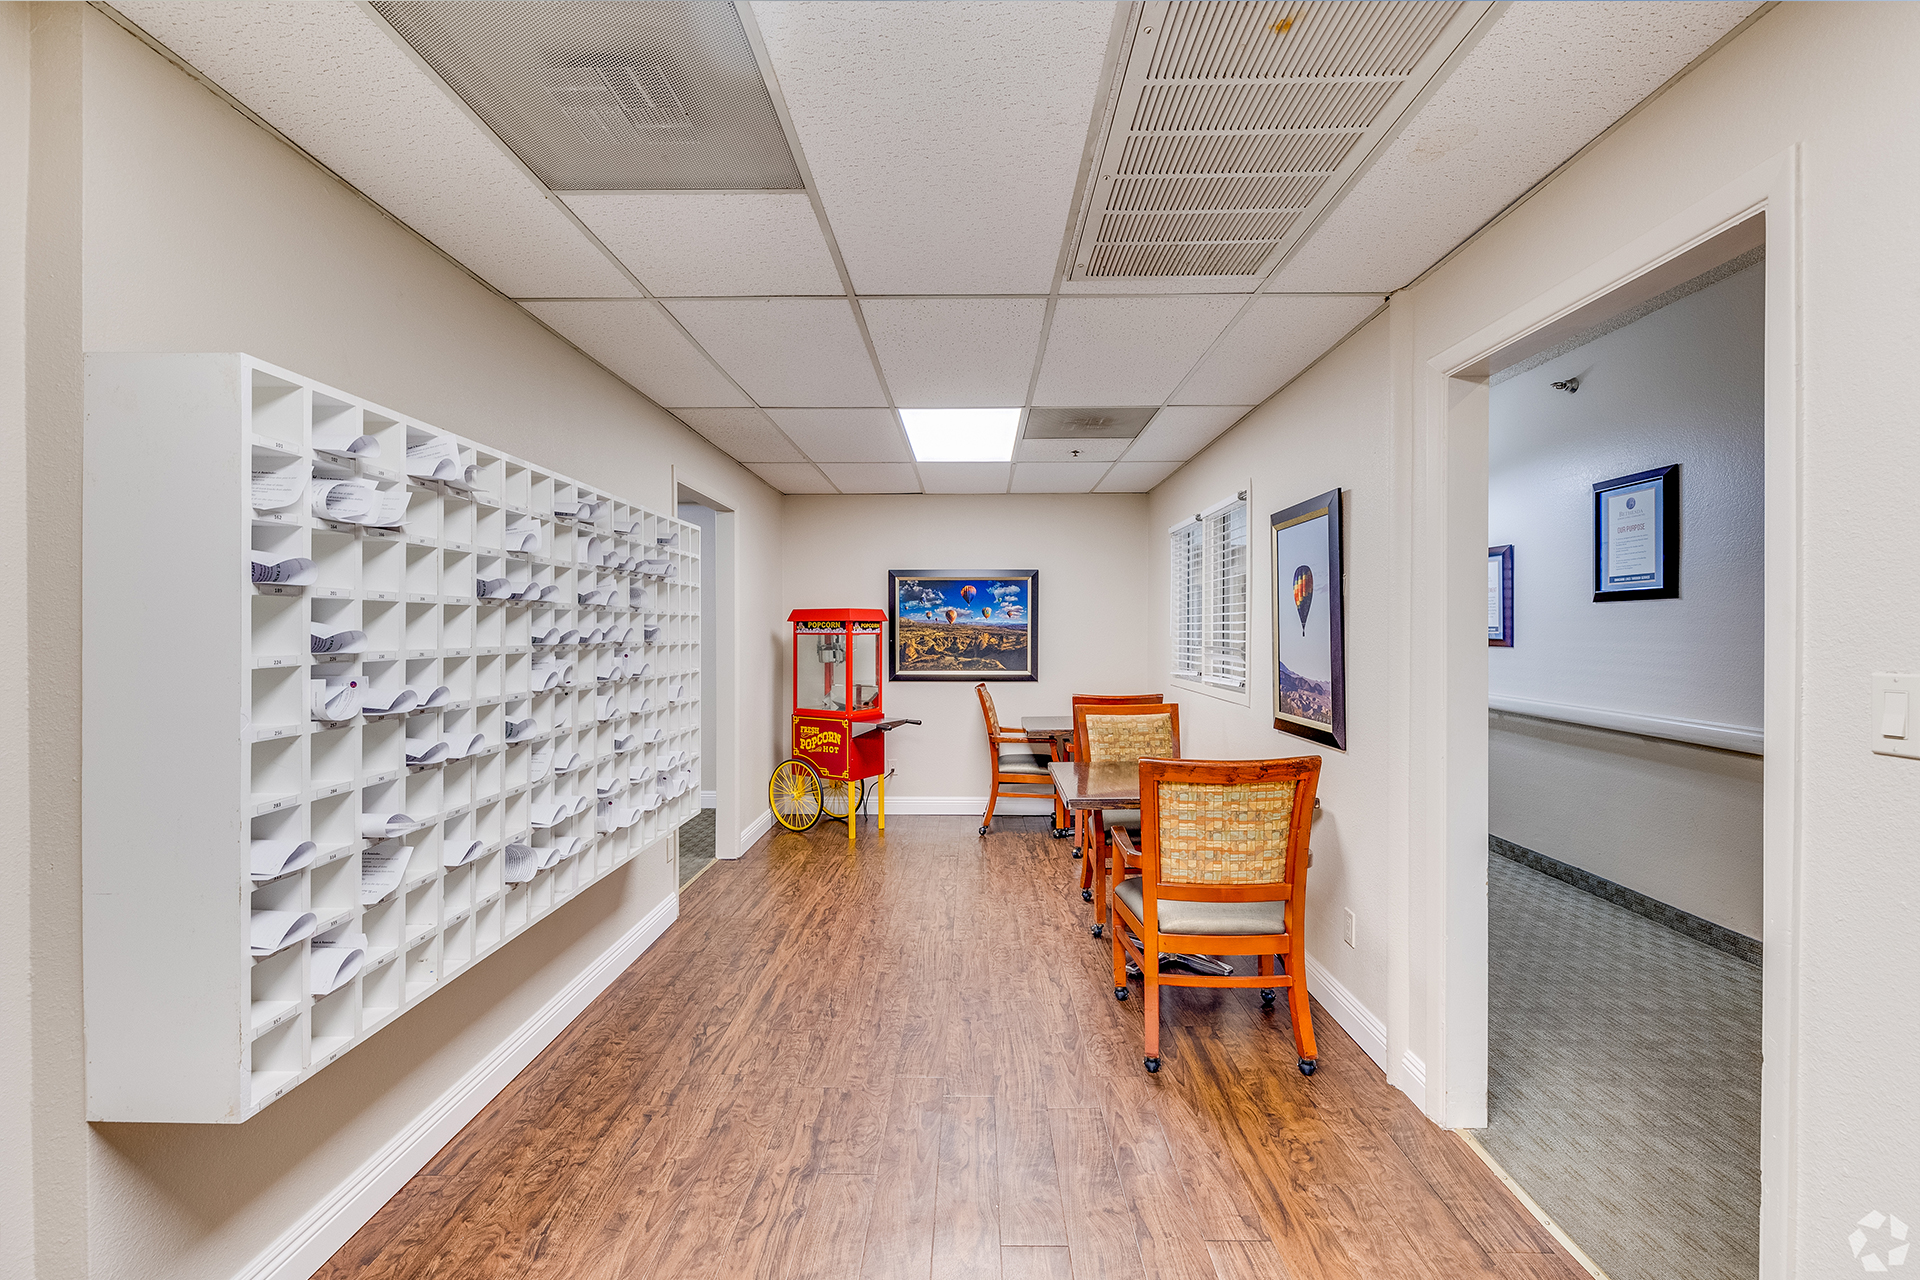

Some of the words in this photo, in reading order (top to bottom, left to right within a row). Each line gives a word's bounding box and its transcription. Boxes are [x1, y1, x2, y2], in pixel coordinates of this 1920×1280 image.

[1626, 523, 1645, 532] PURPOSE
[800, 726, 819, 734] FRESH
[800, 731, 842, 750] POPCORN
